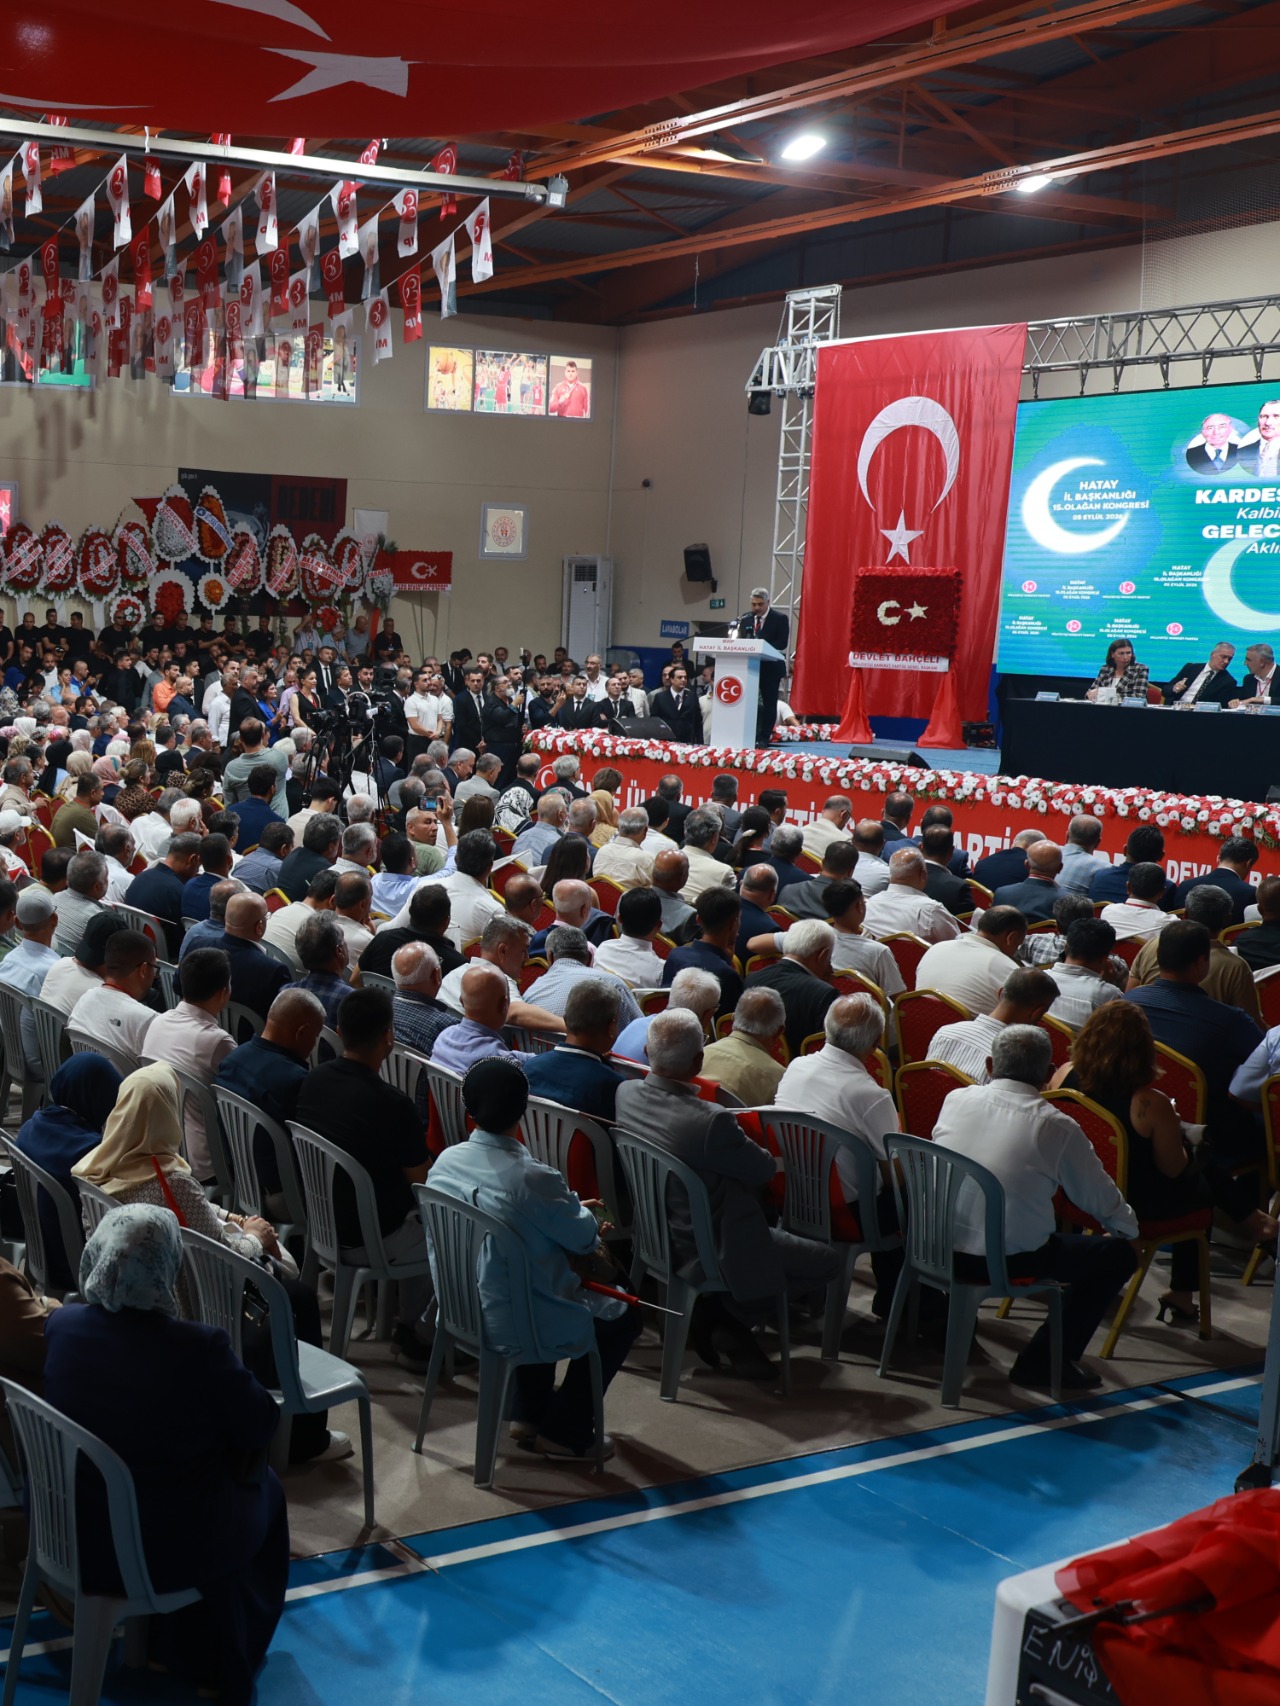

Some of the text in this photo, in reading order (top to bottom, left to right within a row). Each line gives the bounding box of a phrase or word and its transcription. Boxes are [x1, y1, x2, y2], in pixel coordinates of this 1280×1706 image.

[1079, 479, 1119, 491] HATAY
[1063, 489, 1136, 502] İL BAŞKANLIĞI
[1102, 499, 1150, 509] KONGRESİ
[1083, 513, 1104, 521] EYLÜL
[1236, 506, 1280, 520] Kalbi
[852, 653, 940, 664] DEVLET BAHÇELİ
